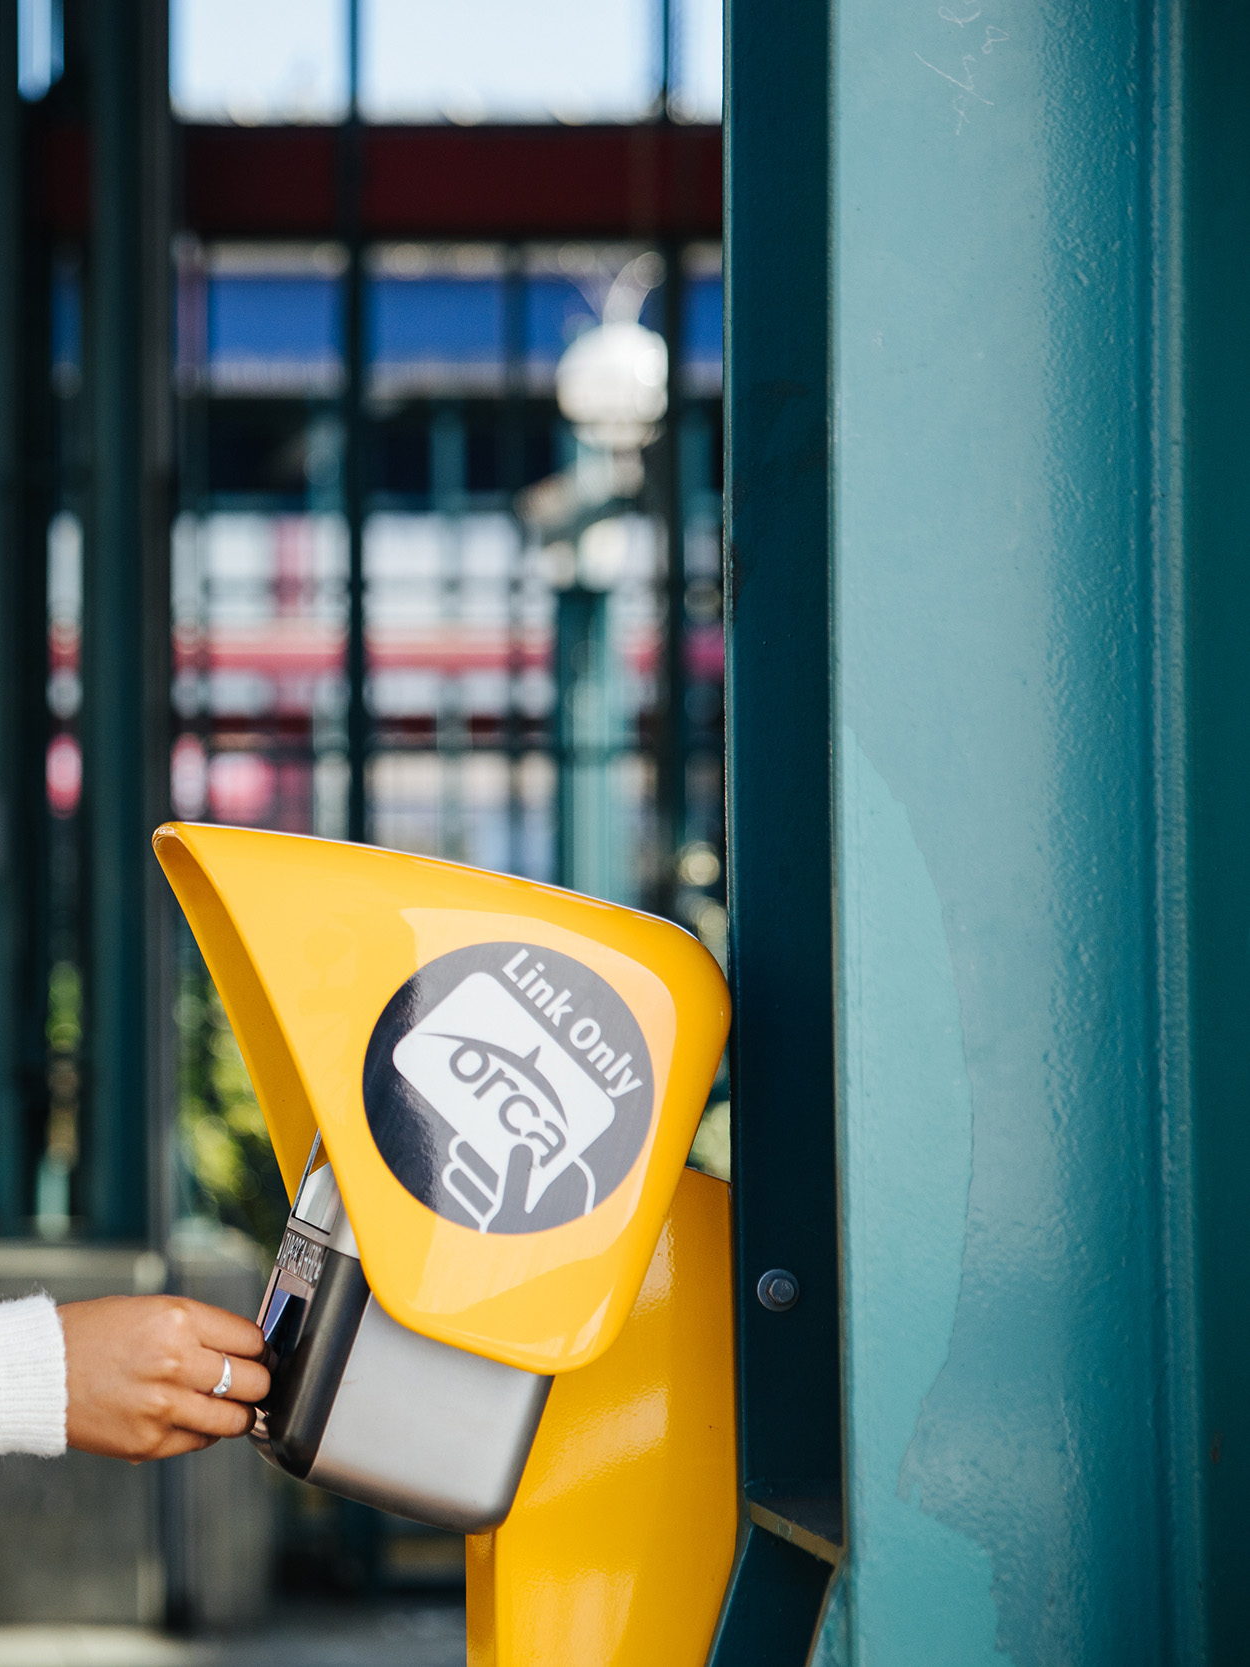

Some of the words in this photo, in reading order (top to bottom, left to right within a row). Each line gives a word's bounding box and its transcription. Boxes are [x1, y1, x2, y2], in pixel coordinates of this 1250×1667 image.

[502, 948, 573, 1027] Link
[569, 1018, 643, 1098] Only
[449, 1043, 566, 1168] orca
